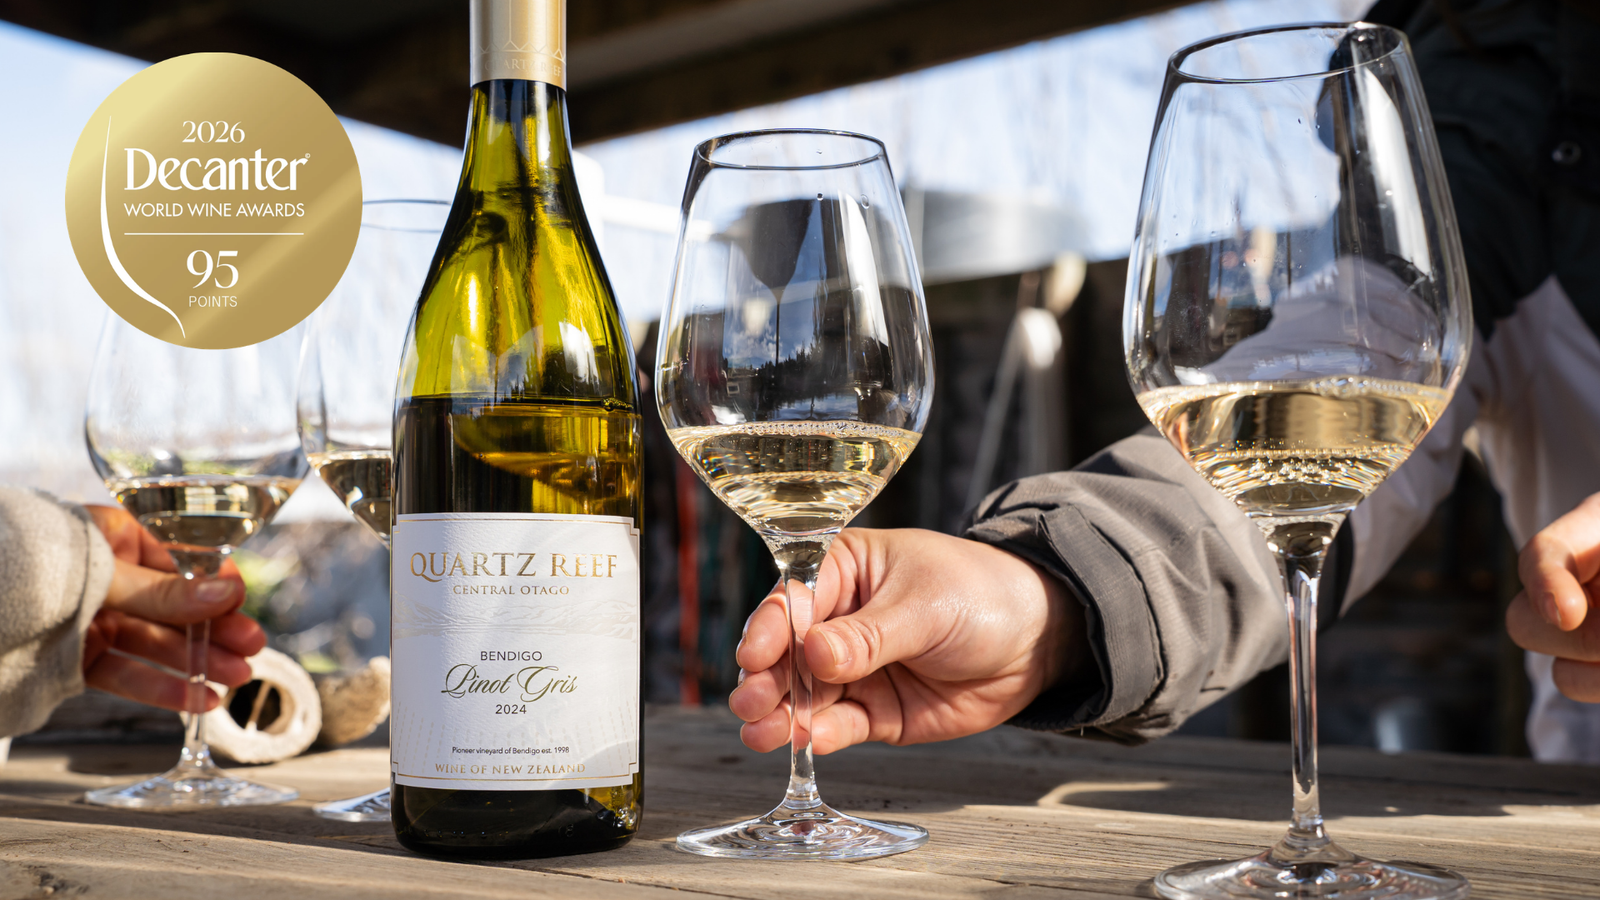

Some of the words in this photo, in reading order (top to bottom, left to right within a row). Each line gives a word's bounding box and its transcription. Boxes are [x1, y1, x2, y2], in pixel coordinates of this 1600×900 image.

[484, 58, 536, 71] ARTZ
[541, 61, 562, 77] REF
[410, 552, 537, 583] QUARTZ
[549, 552, 618, 578] REEF
[453, 585, 515, 595] CENTRAL
[520, 585, 569, 595] OTAGO
[480, 651, 543, 661] BENDIGO
[441, 663, 515, 699] Pinot
[516, 665, 578, 703] Gris
[495, 704, 527, 715] 2024
[452, 746, 475, 754] Pioneer
[476, 746, 503, 756] vineyard
[504, 746, 511, 754] of
[512, 746, 540, 756] Bendigo
[554, 746, 570, 754] 1998
[434, 763, 466, 774] WINE
[470, 764, 487, 774] OF
[492, 765, 523, 774] NEW
[527, 763, 586, 774] ZEALAND
